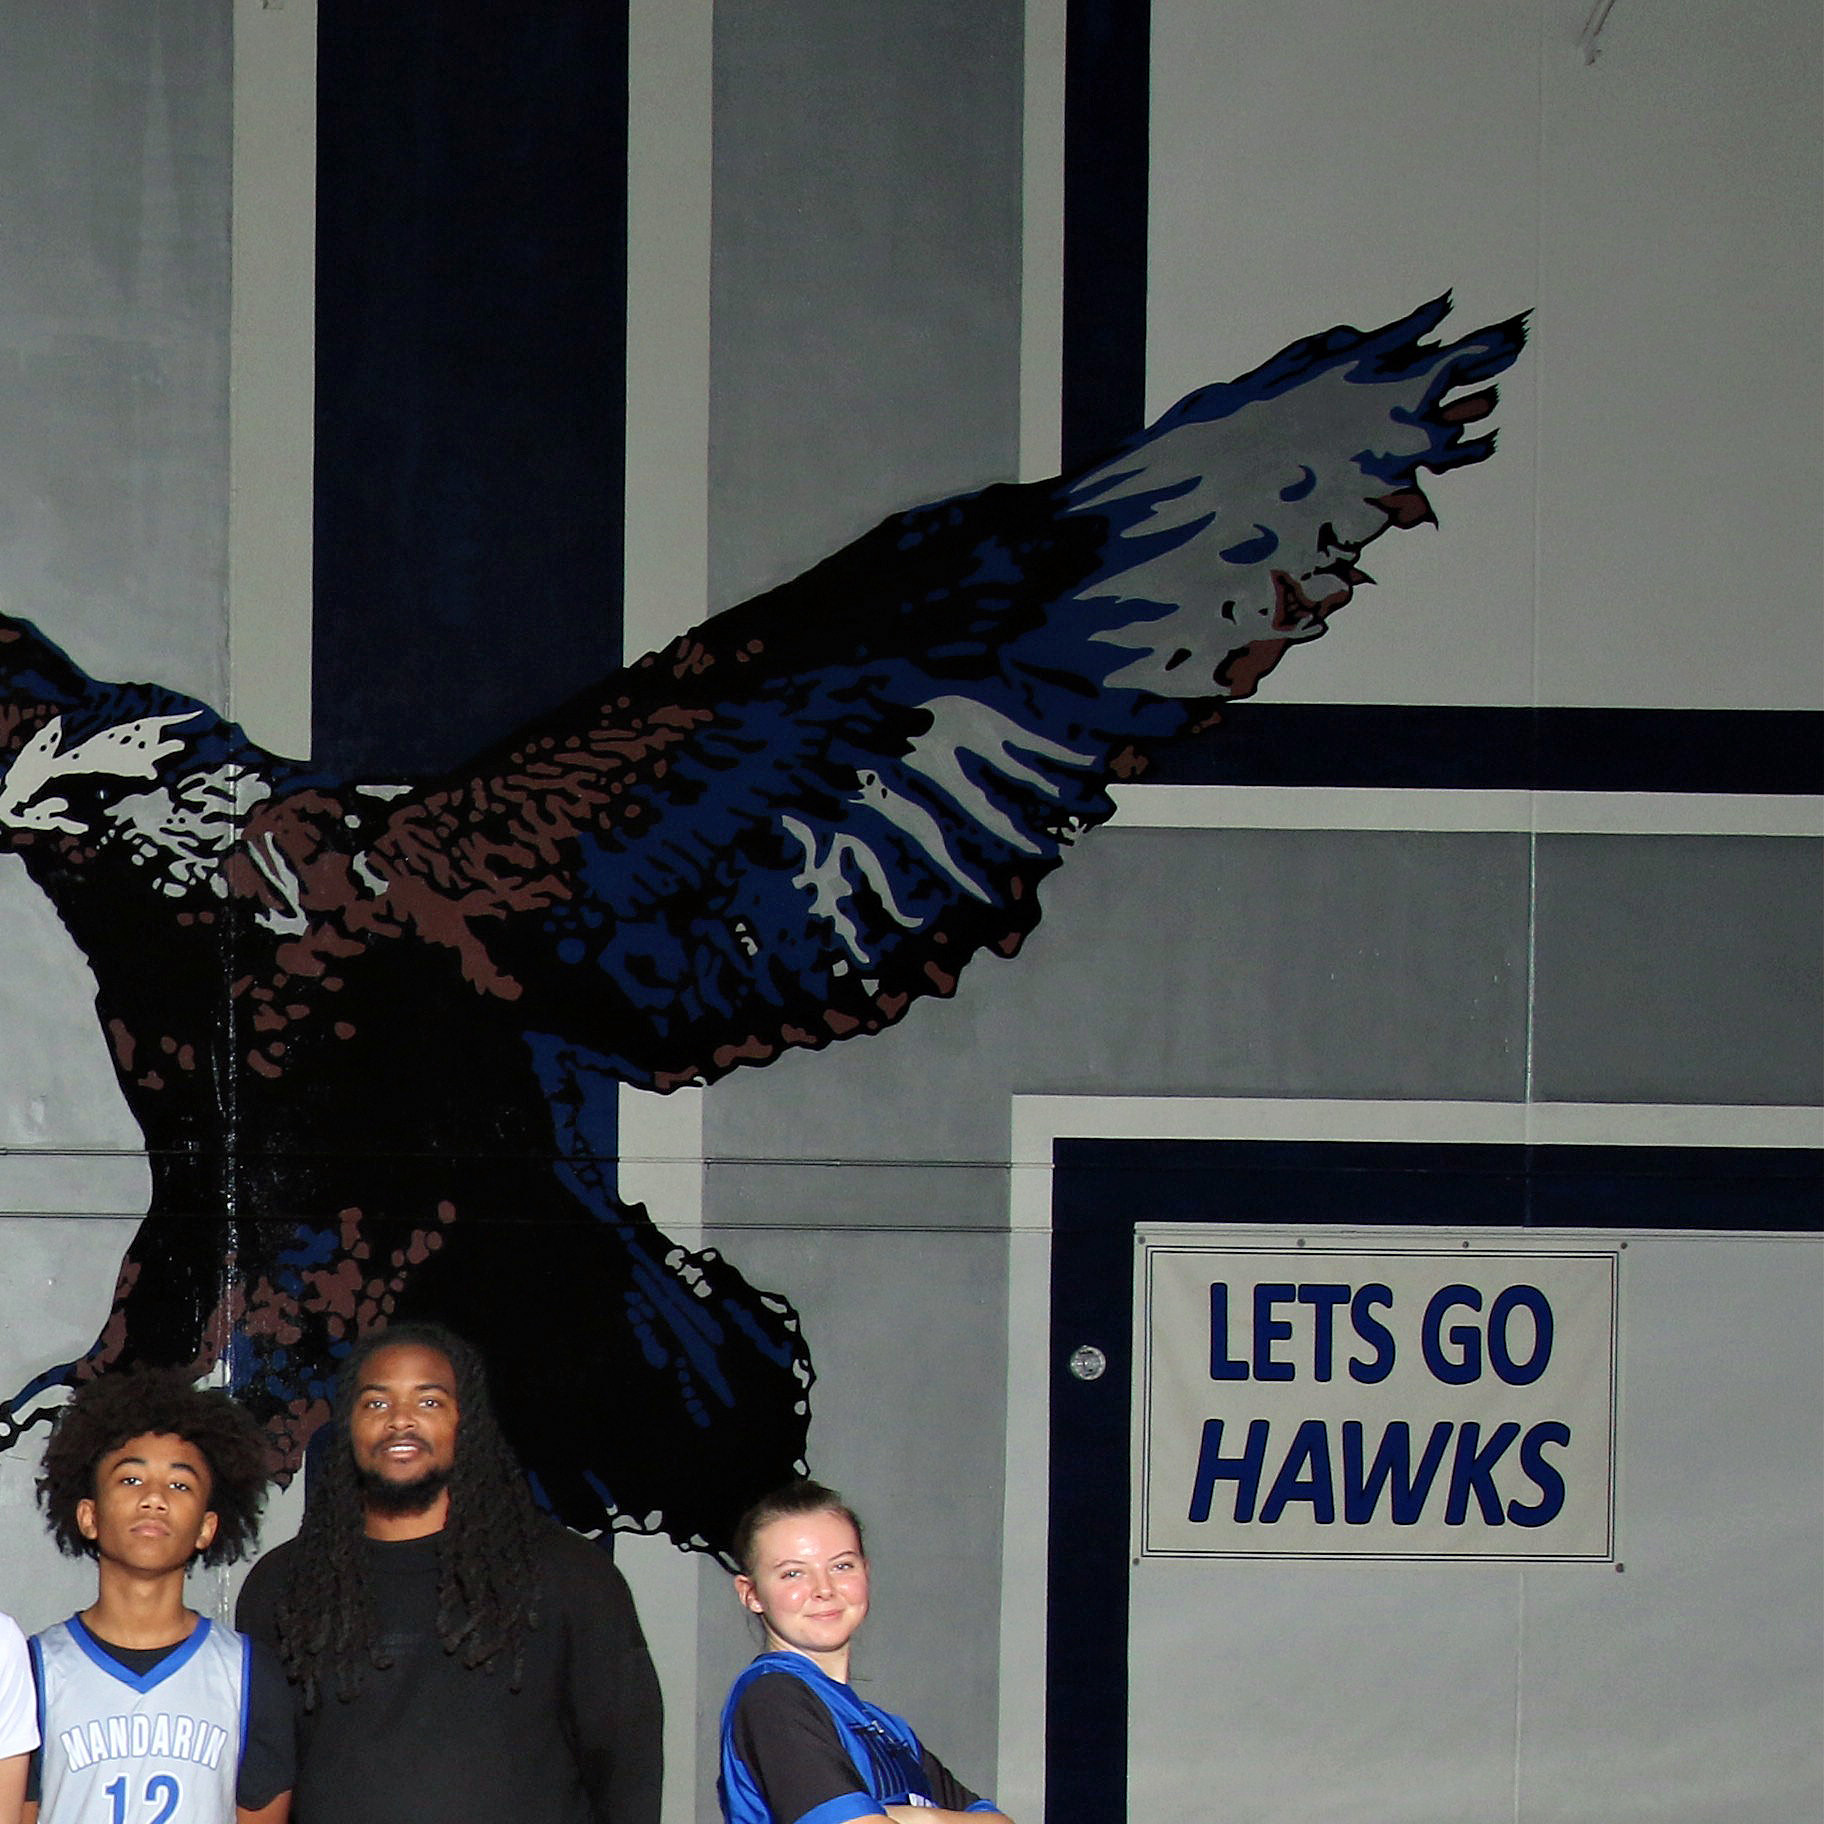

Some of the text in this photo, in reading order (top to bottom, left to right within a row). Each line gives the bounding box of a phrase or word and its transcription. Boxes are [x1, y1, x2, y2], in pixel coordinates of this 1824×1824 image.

[1209, 1281, 1554, 1387] LETS GO
[1187, 1418, 1571, 1529] HAWKS
[60, 1712, 229, 1773] MANDARIN
